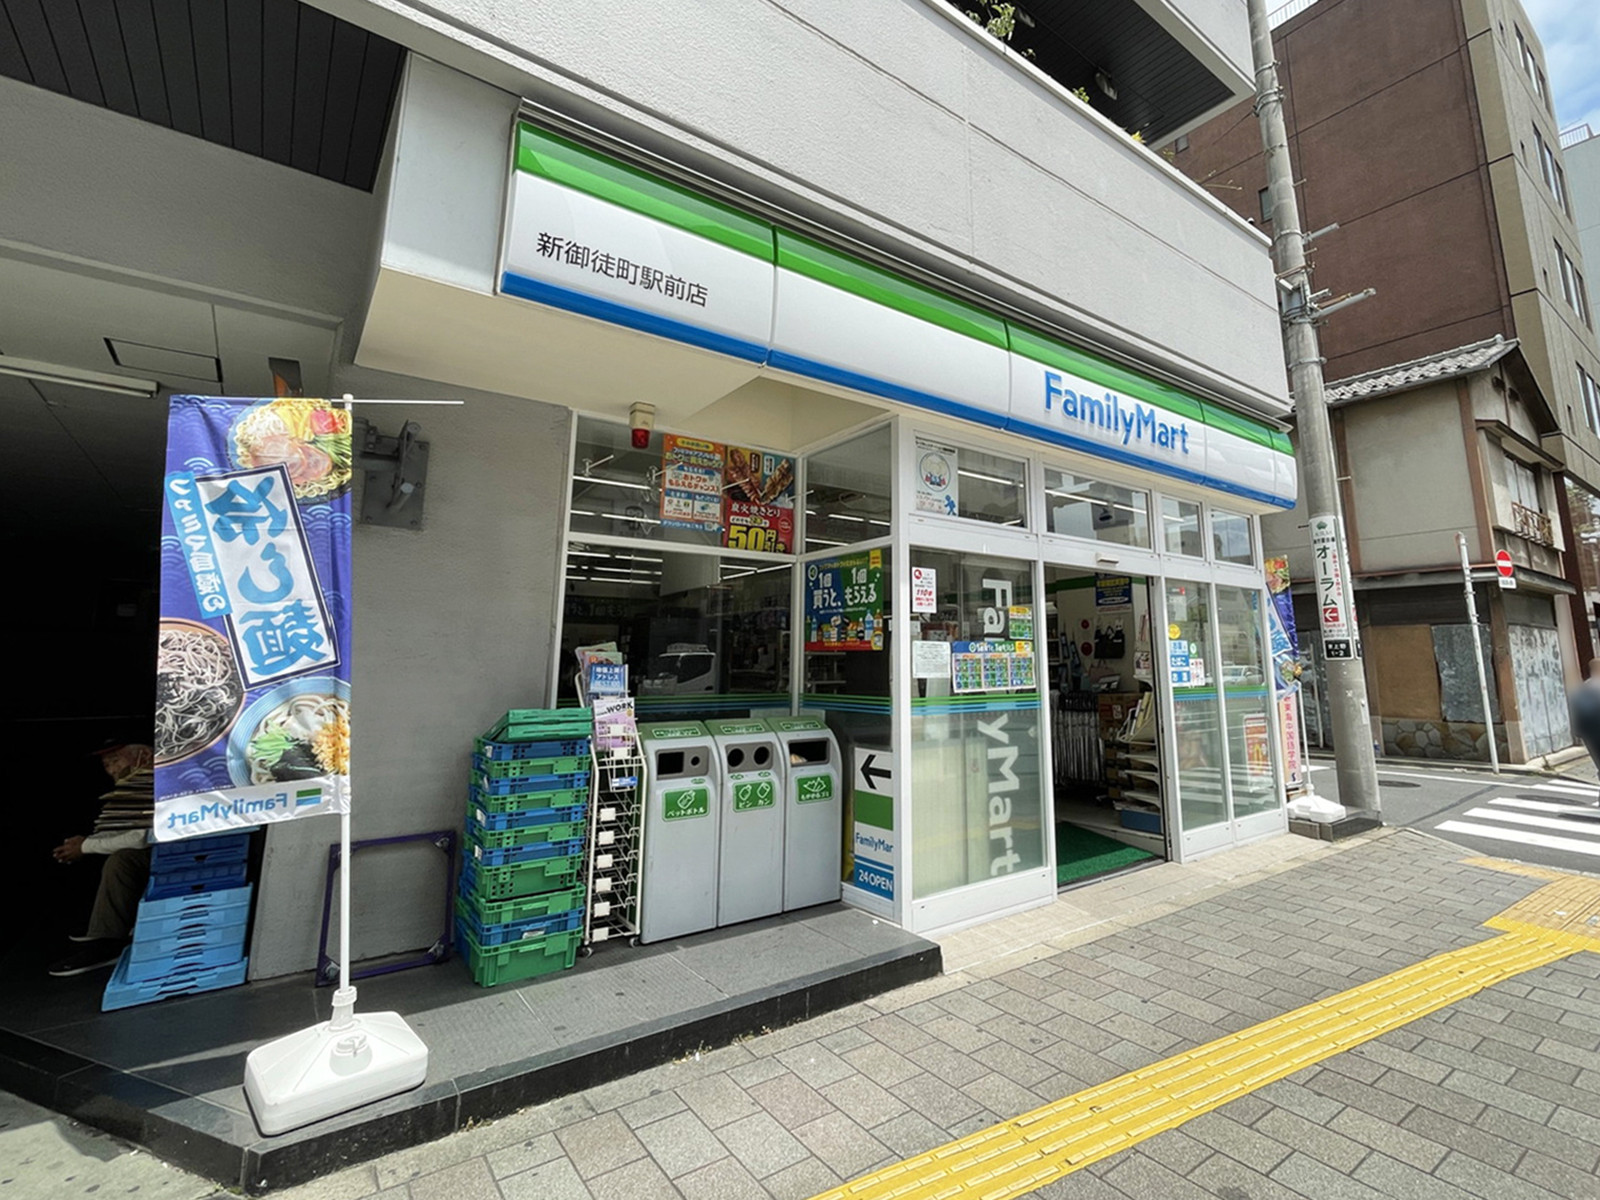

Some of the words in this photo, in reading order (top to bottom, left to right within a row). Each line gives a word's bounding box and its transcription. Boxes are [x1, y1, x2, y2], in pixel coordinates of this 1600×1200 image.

[536, 232, 708, 307] 新御徒町駅前店
[1044, 371, 1190, 454] FamilyMart
[819, 572, 832, 588] 1個
[852, 567, 867, 584] 1個
[1316, 545, 1338, 607] オーラム
[813, 588, 842, 609] 買うと、
[845, 583, 877, 606] もらえる
[606, 701, 634, 714] WORK
[666, 805, 706, 817] ペットボトル
[738, 801, 752, 809] ビン
[757, 797, 771, 806] カン
[855, 832, 894, 853] FamilyMar
